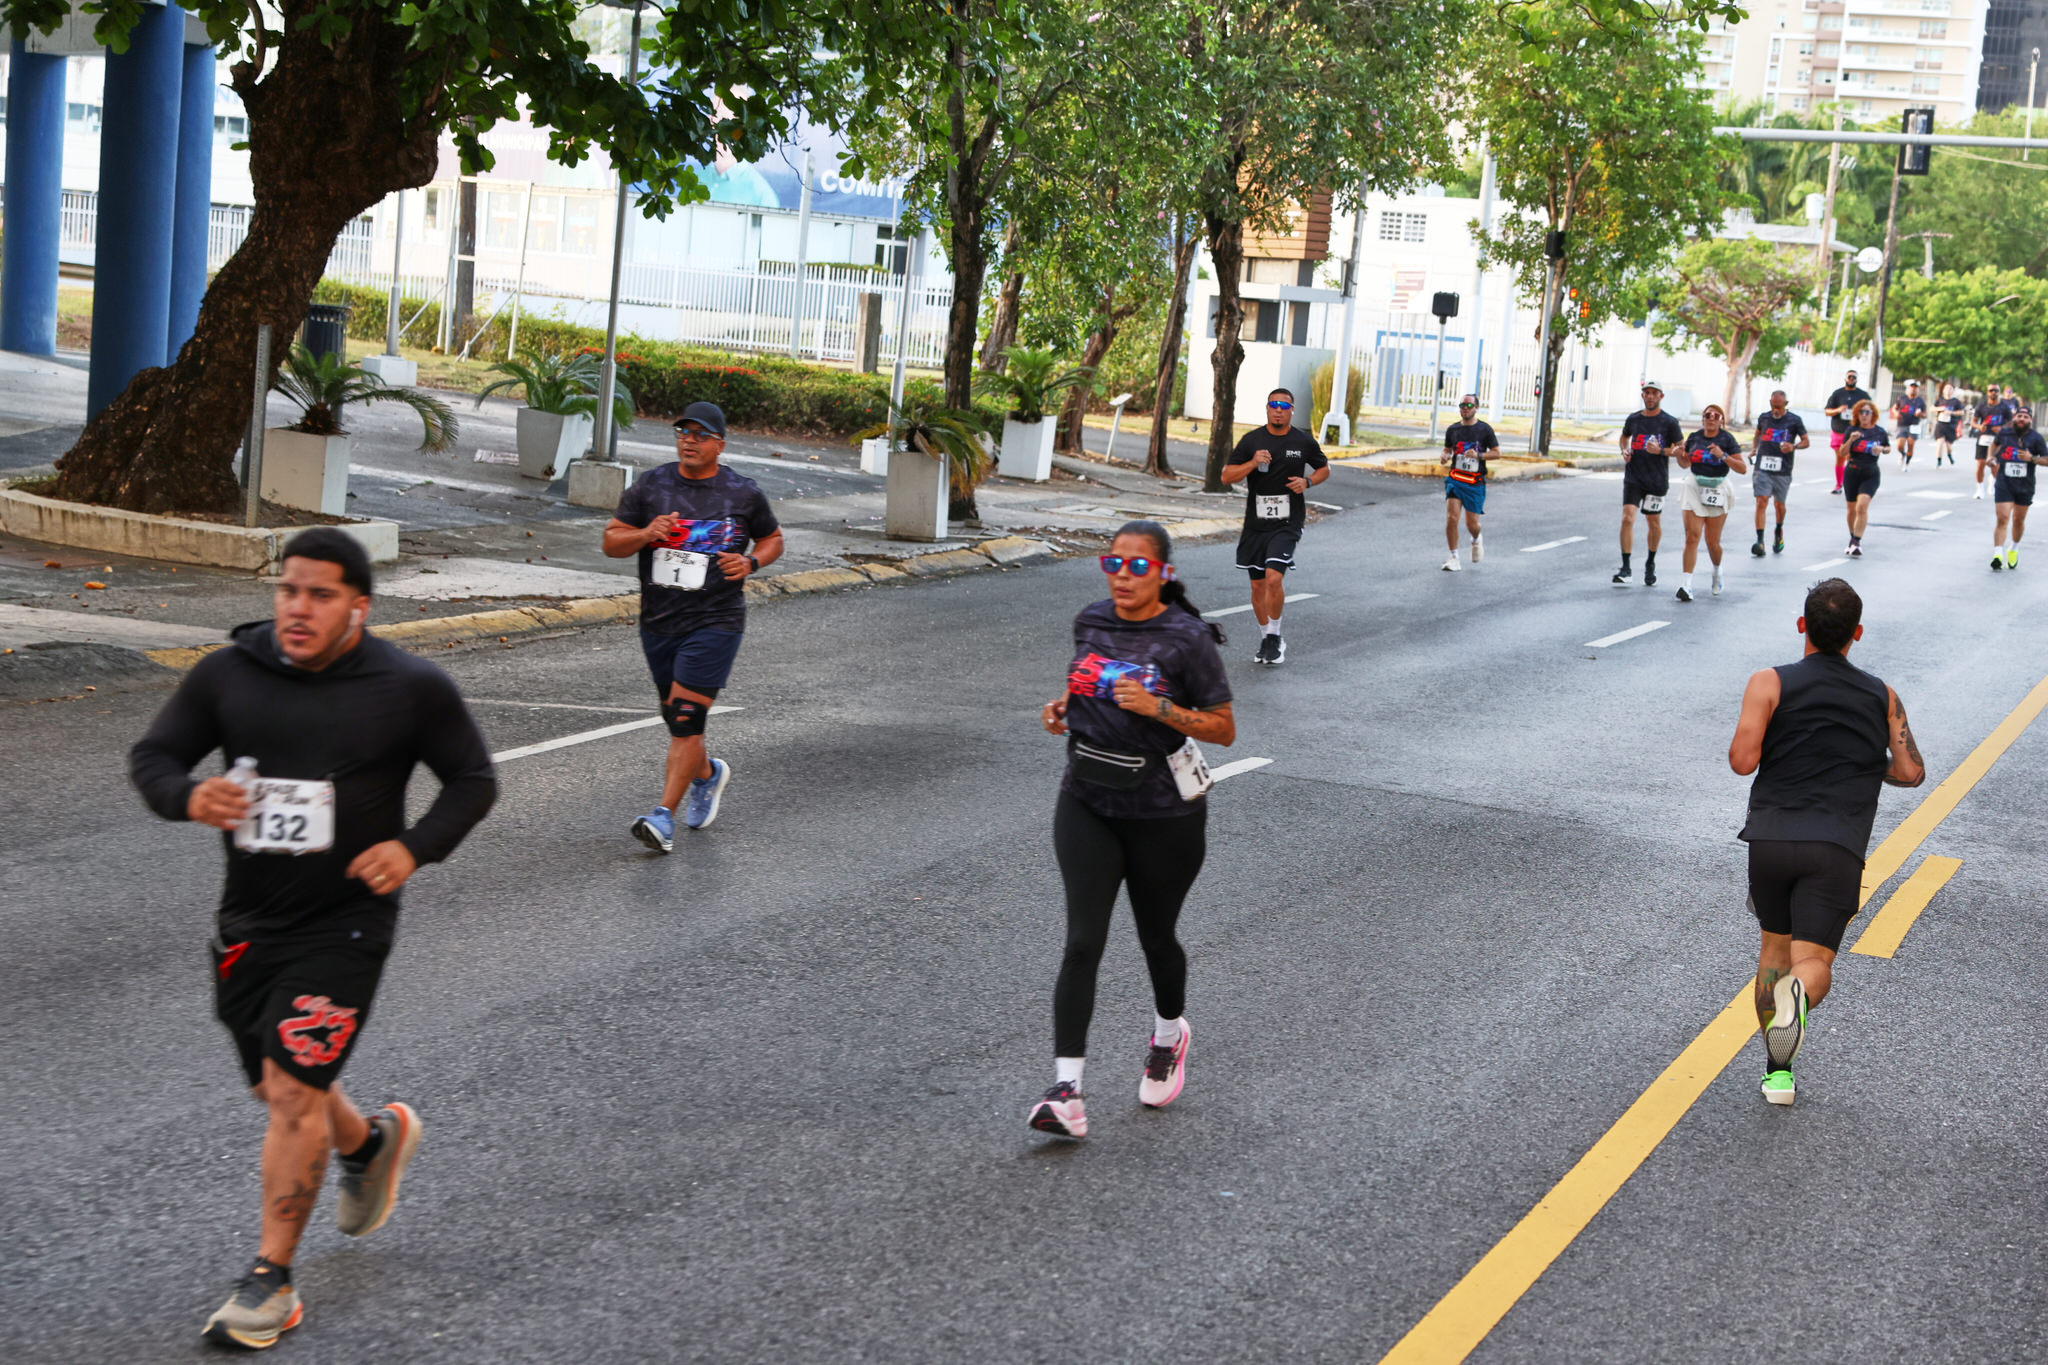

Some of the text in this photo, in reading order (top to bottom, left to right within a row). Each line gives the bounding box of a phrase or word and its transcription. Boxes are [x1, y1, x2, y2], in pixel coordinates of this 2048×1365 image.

[1706, 496, 1717, 504] 42
[1266, 506, 1278, 516] 21
[673, 568, 680, 583] 1
[252, 812, 308, 842] 132
